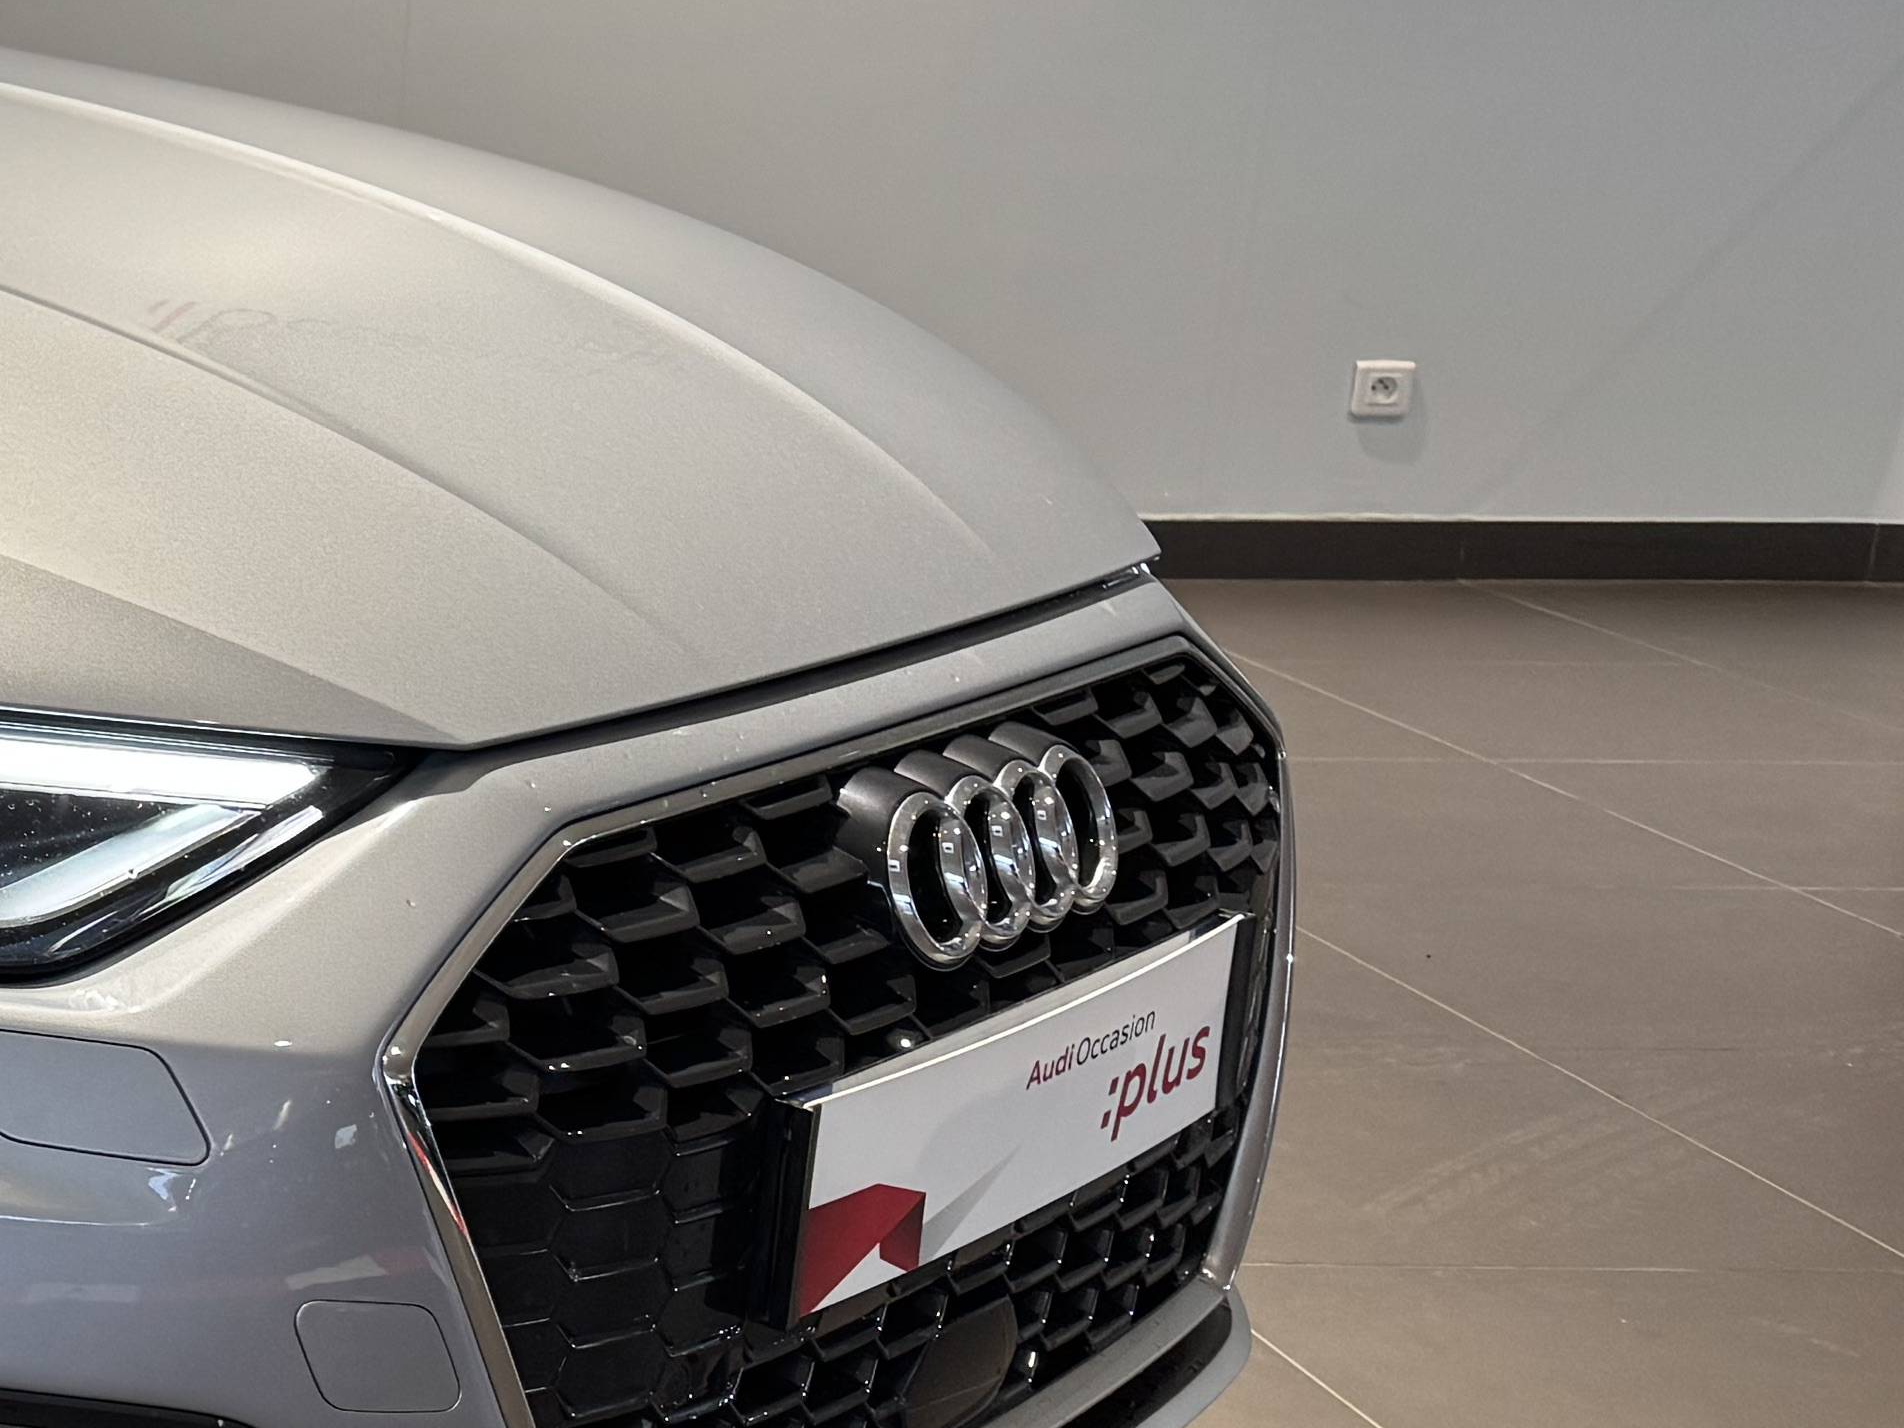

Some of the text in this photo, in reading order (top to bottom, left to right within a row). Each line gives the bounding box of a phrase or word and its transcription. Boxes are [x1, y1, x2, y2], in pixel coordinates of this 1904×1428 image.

[1026, 1010, 1155, 1090] Audi Occasion
[1100, 1025, 1210, 1142] :plus
